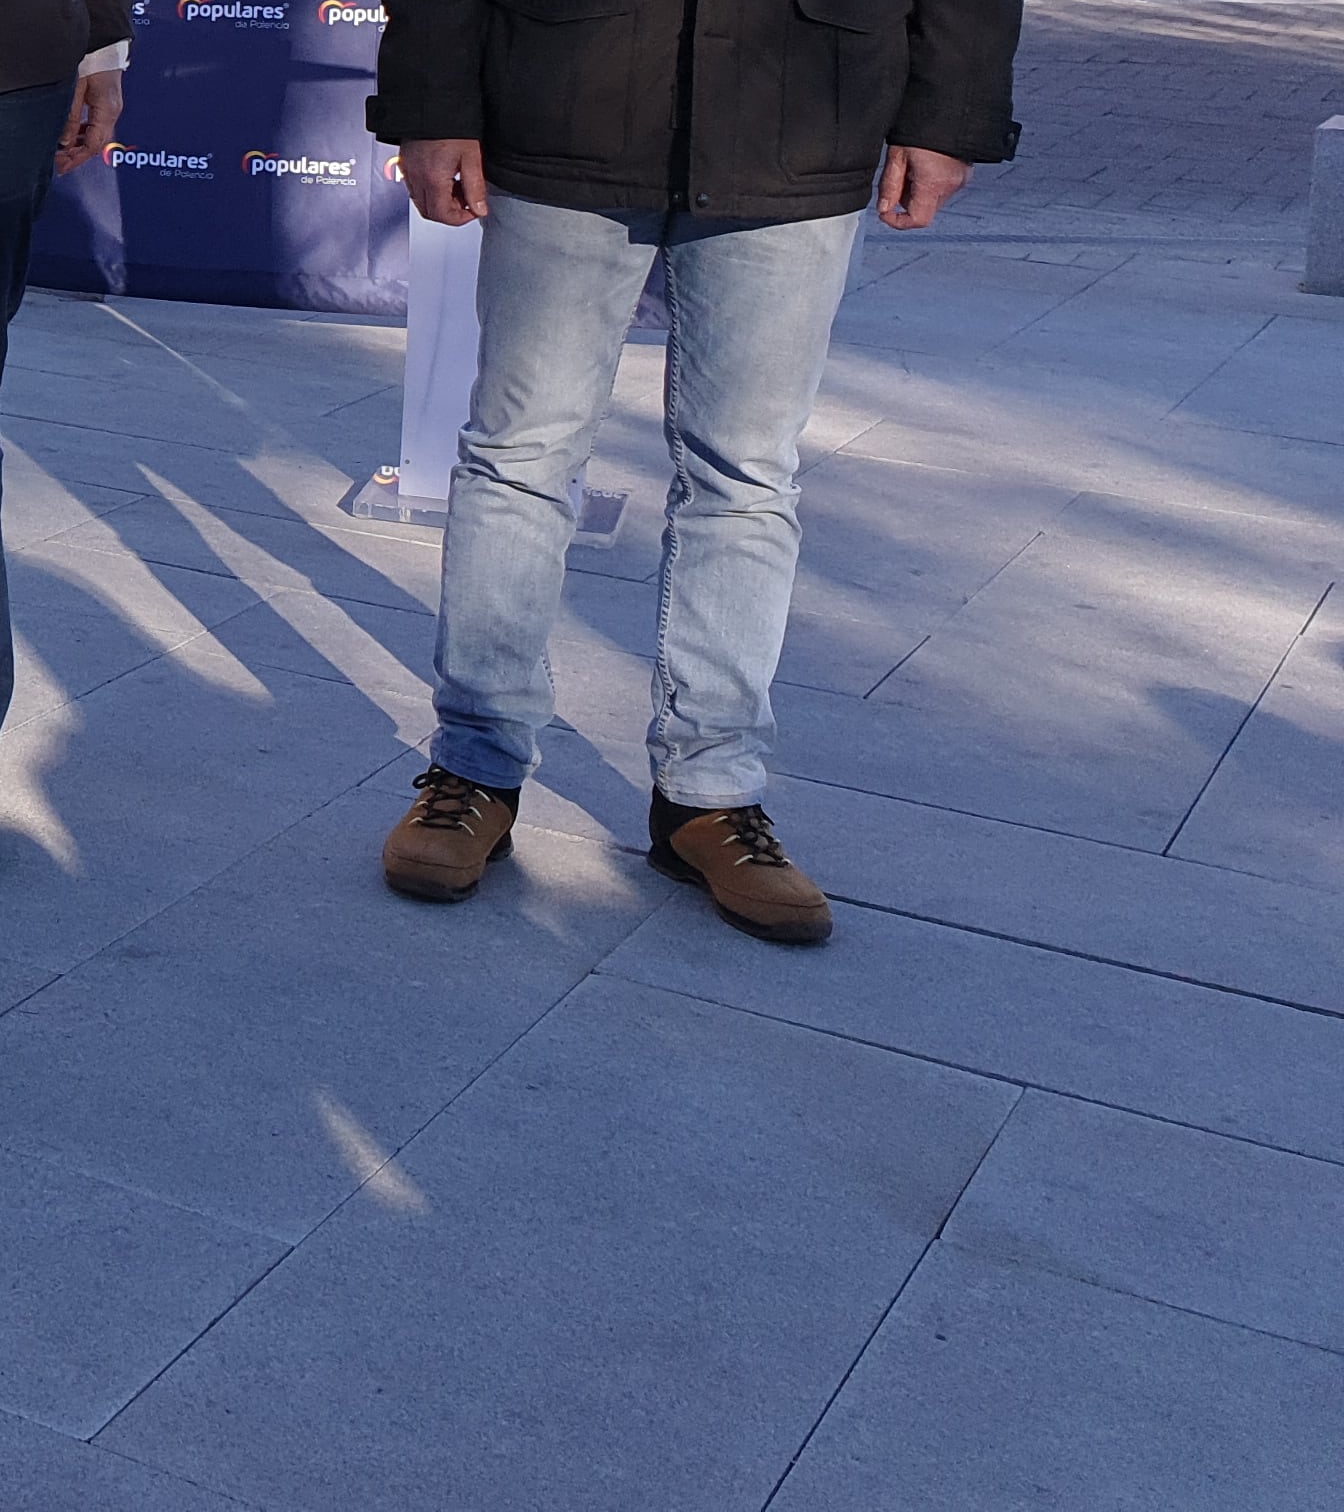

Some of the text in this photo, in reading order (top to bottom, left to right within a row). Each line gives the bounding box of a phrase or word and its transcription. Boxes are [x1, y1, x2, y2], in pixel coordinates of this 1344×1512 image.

[186, 1, 285, 22] populares
[328, 5, 389, 27] popul
[234, 19, 290, 30] de Palencia
[112, 148, 209, 170] populares
[251, 155, 351, 176] populares
[159, 168, 214, 180] de Palencia
[300, 175, 357, 187] de Palencia
